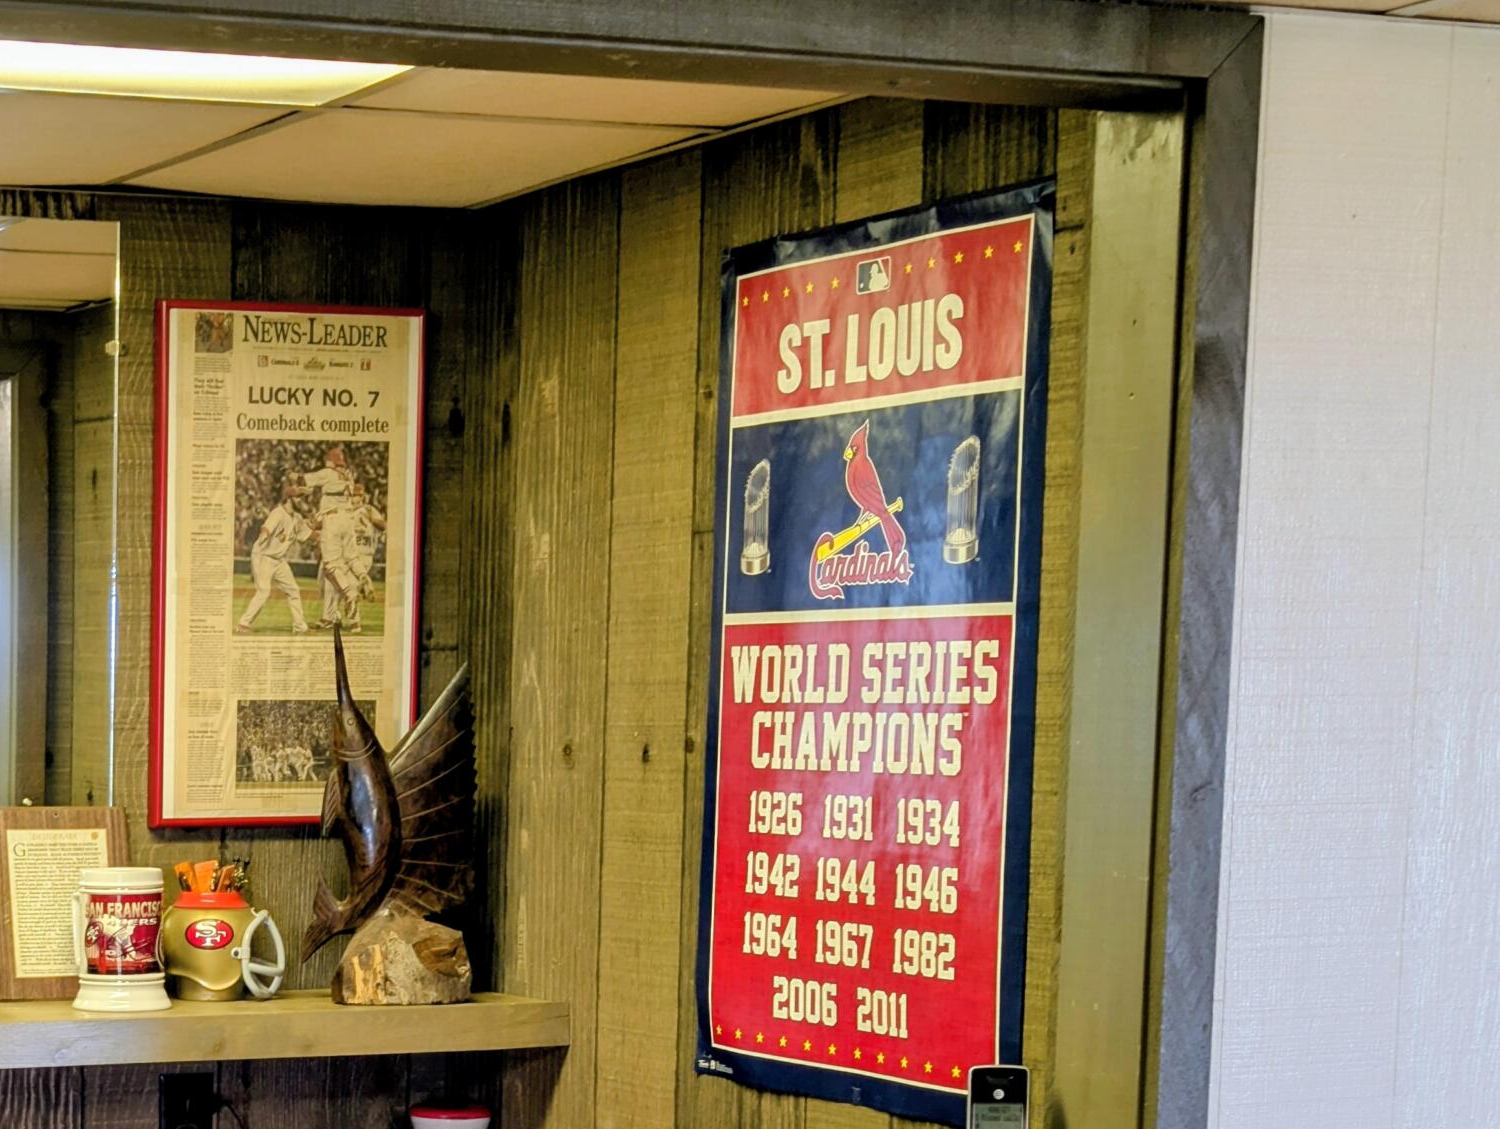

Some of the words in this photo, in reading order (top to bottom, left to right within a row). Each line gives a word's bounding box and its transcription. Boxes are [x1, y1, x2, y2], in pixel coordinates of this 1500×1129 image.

[777, 318, 836, 395] ST.
[845, 293, 965, 384] LOUIS
[236, 412, 315, 433] Comeback
[320, 416, 389, 436] complete
[248, 386, 314, 406] LUCKY
[322, 388, 358, 407] NO.
[368, 391, 380, 408] 7
[809, 532, 911, 599] Cardinals
[731, 641, 851, 704] WORLD
[861, 639, 1000, 705] SERIES
[751, 711, 963, 776] CHAMPIONS
[749, 790, 802, 837] 1926
[822, 794, 874, 842] 1931
[897, 796, 960, 848] 1934
[745, 851, 800, 898] 1942
[816, 856, 876, 906] 1944
[894, 863, 959, 915] 1946
[194, 921, 227, 947] SF
[742, 911, 797, 960] 1964
[815, 919, 874, 969] 1967
[893, 928, 957, 981] 1982
[772, 976, 838, 1027] 2006
[856, 987, 908, 1039] 2011
